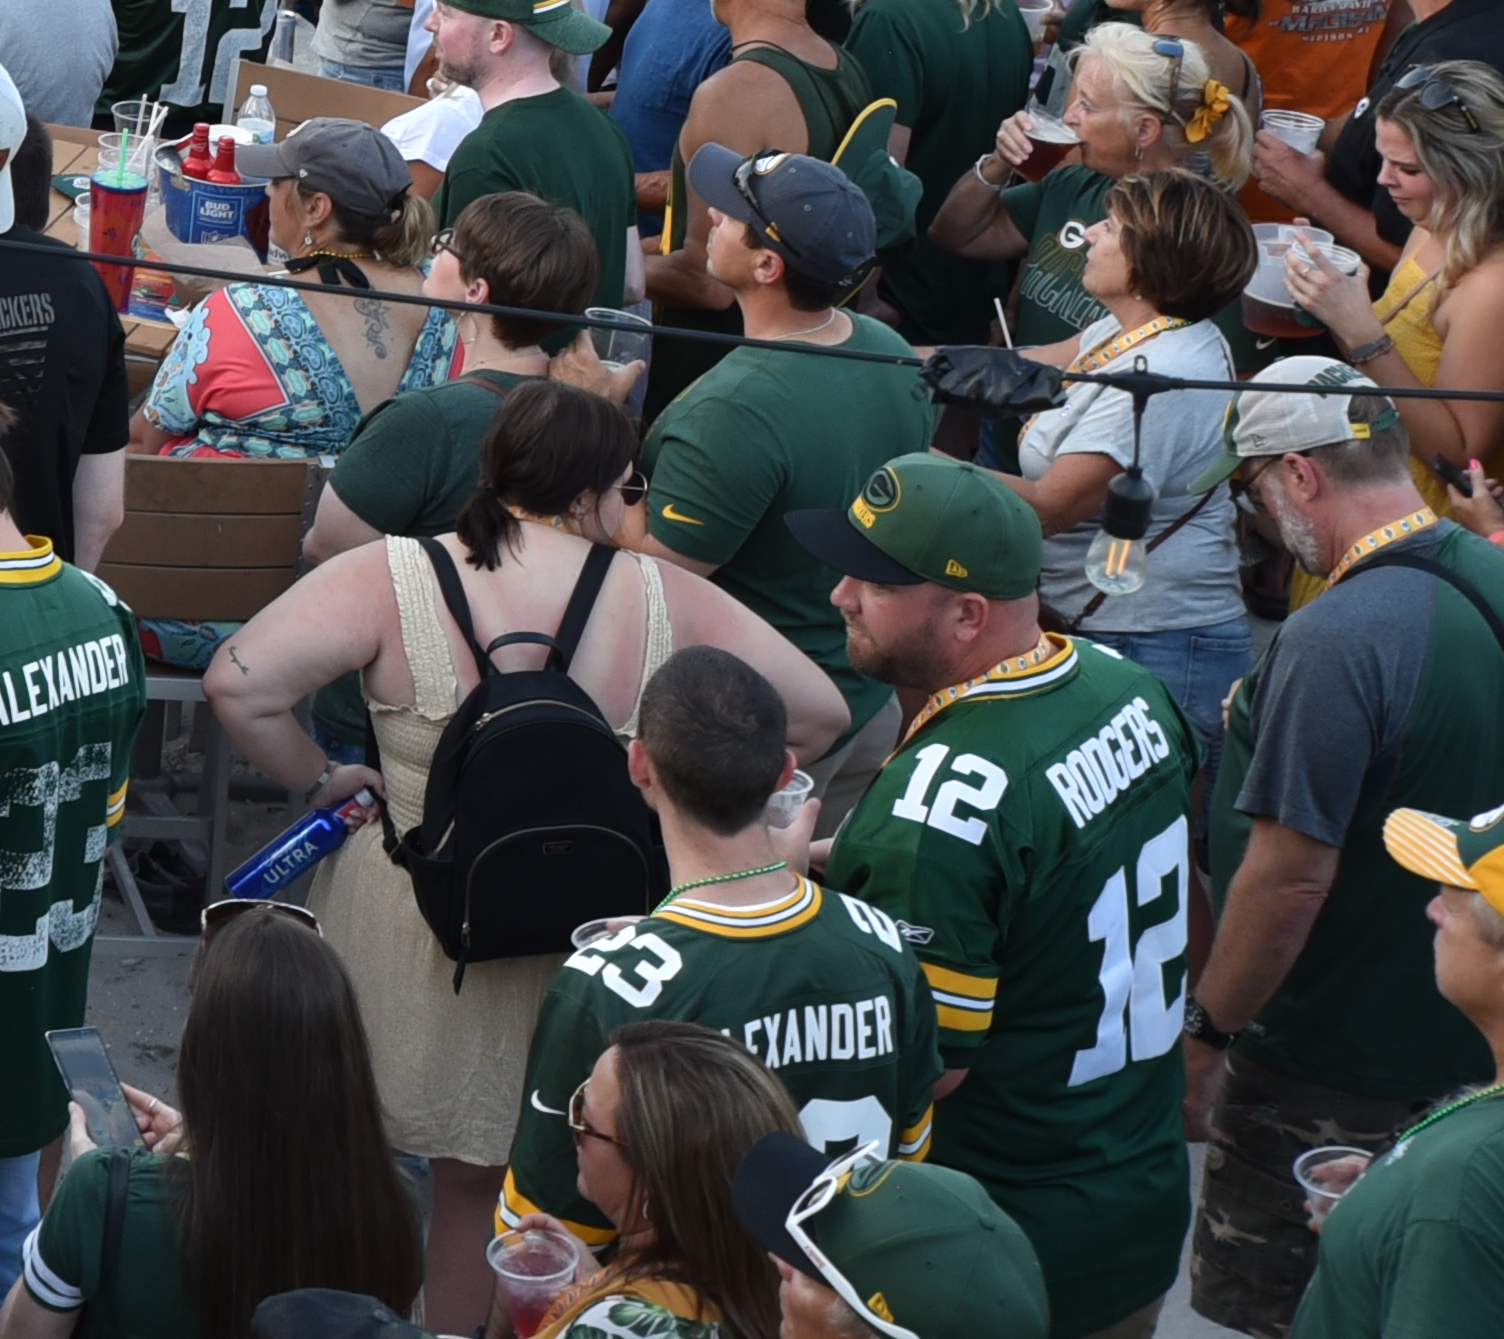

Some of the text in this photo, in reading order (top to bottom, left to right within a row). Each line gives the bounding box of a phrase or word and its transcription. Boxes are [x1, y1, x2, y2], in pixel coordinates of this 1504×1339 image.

[199, 206, 235, 220] LIGHT
[204, 200, 230, 212] BUD
[891, 743, 1009, 846] 12
[1044, 696, 1170, 829] RODGERS
[262, 840, 320, 886] ULTRA
[562, 925, 684, 1009] 23
[1066, 812, 1189, 1088] 12
[742, 995, 893, 1069] EXANDER
